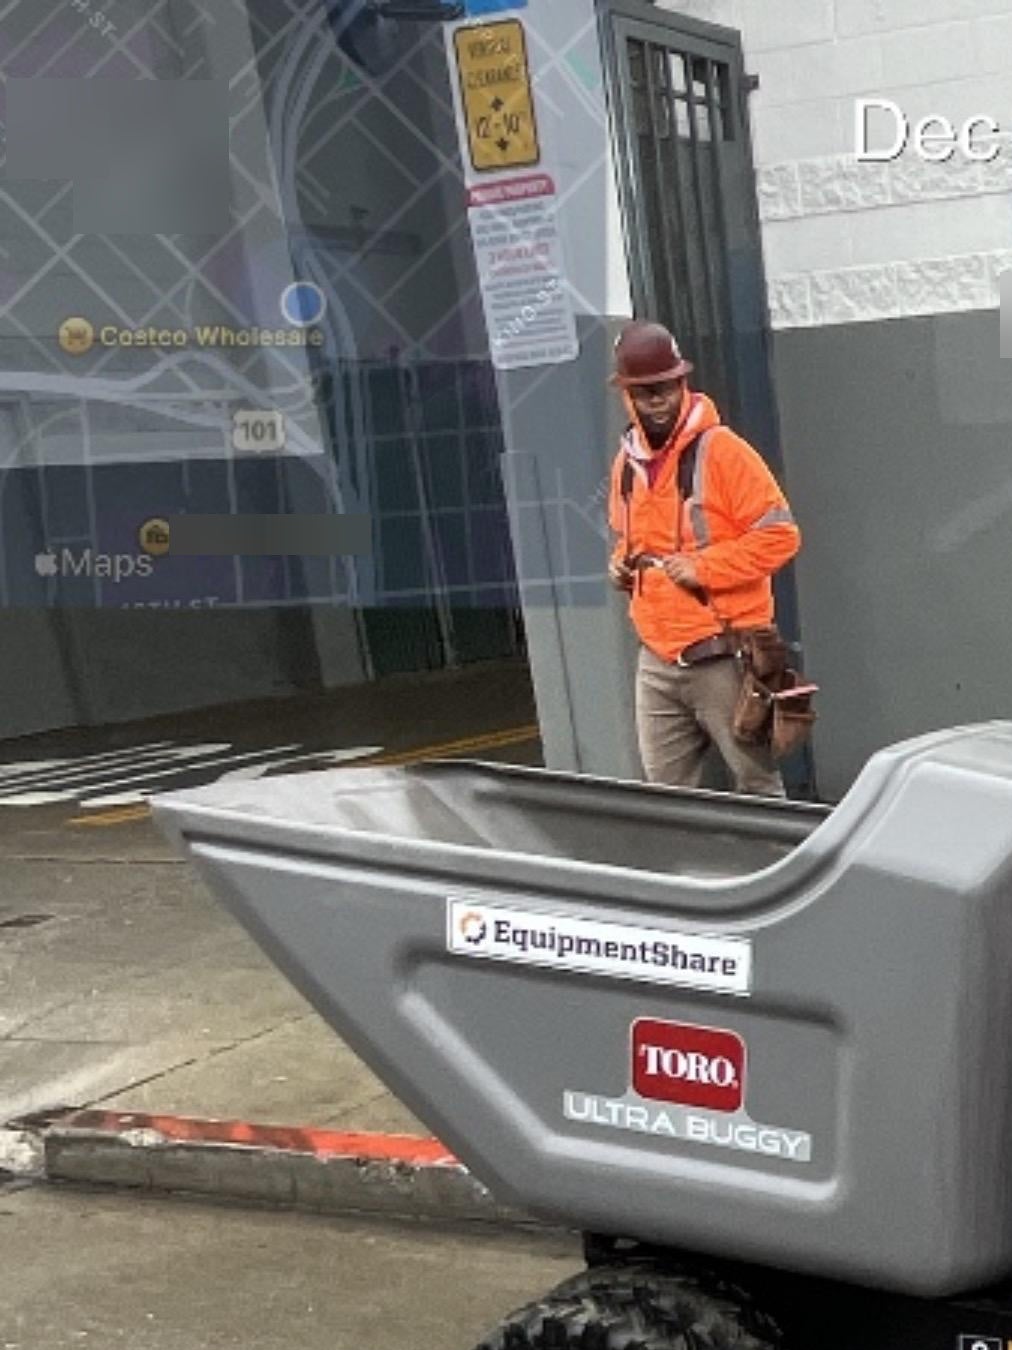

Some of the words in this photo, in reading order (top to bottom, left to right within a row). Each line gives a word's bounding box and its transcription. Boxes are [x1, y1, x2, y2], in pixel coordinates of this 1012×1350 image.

[494, 919, 738, 977] EquipmentShare
[638, 1044, 736, 1087] TORO
[567, 1094, 676, 1137] ULTRA
[687, 1116, 802, 1157] BUGGY
